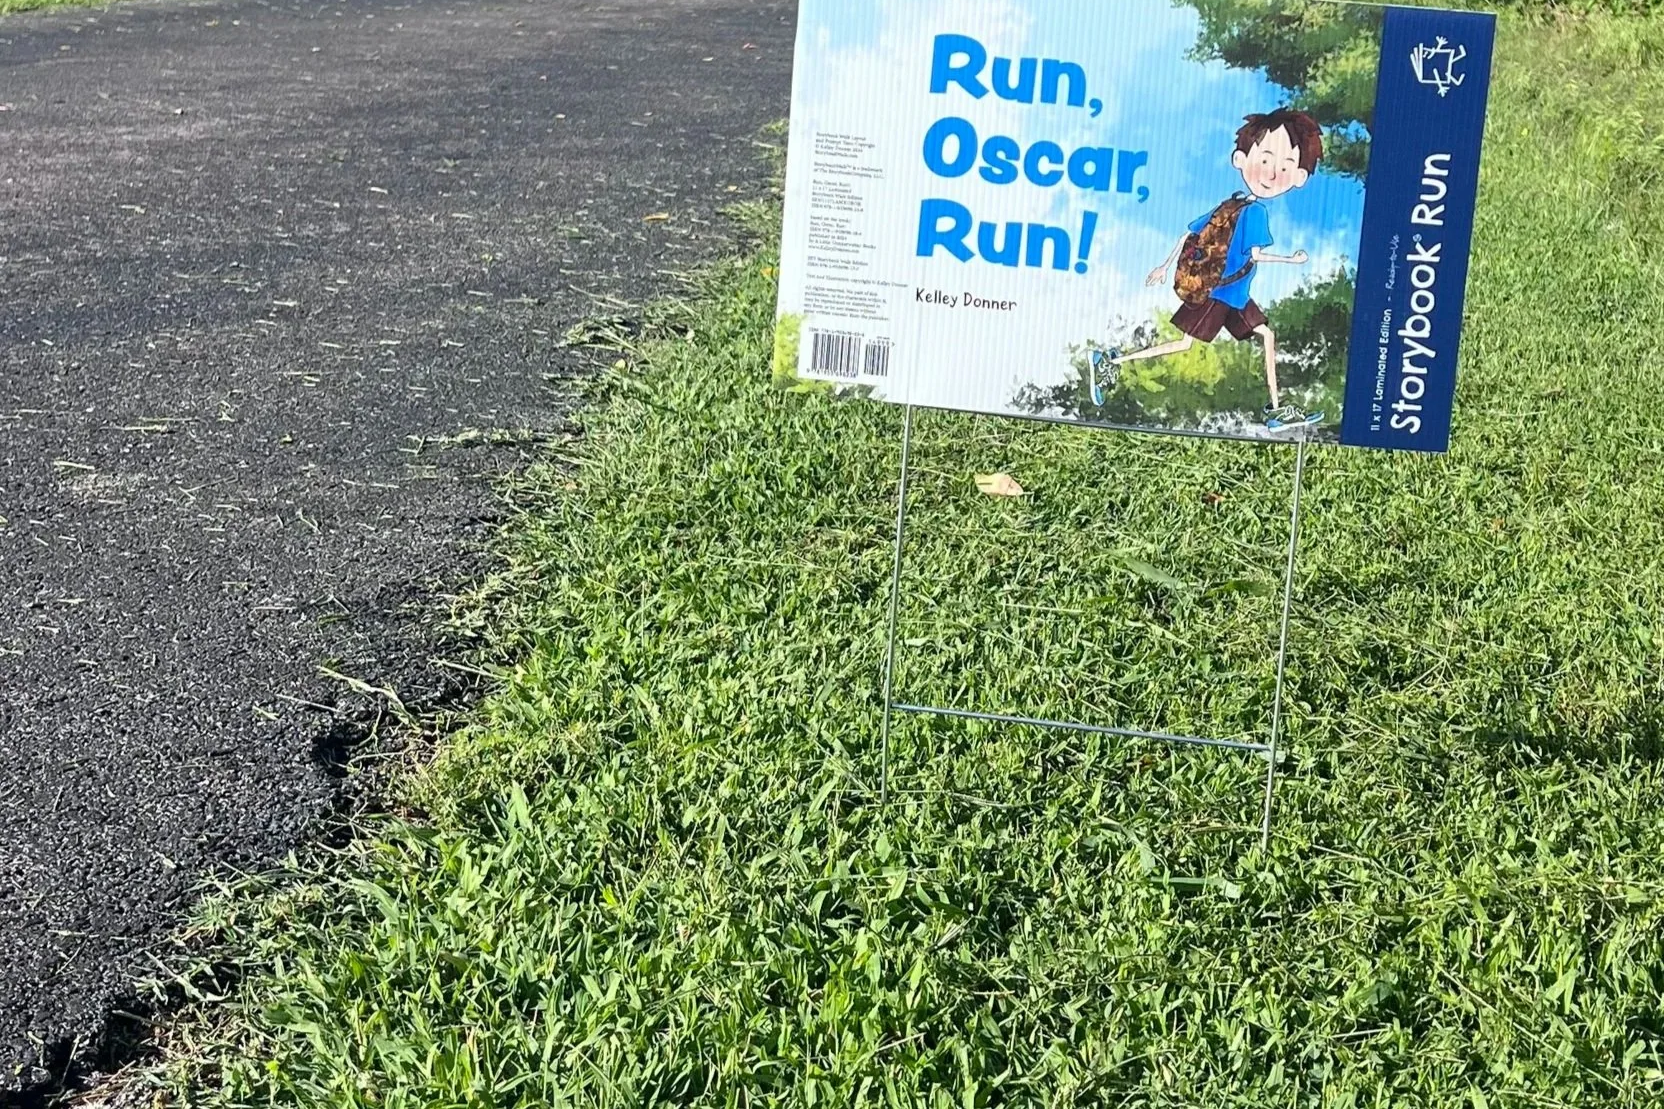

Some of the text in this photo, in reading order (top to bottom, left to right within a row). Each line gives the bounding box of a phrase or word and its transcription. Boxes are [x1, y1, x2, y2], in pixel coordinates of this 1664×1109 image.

[929, 33, 1103, 119] Run,
[922, 116, 1150, 204] Oscar,
[1410, 152, 1452, 227] Run
[916, 198, 1099, 275] Run!
[915, 288, 1018, 312] Kelley Donner
[1379, 308, 1392, 345] Edition
[1373, 347, 1389, 401] Laminated
[1373, 403, 1383, 412] 17
